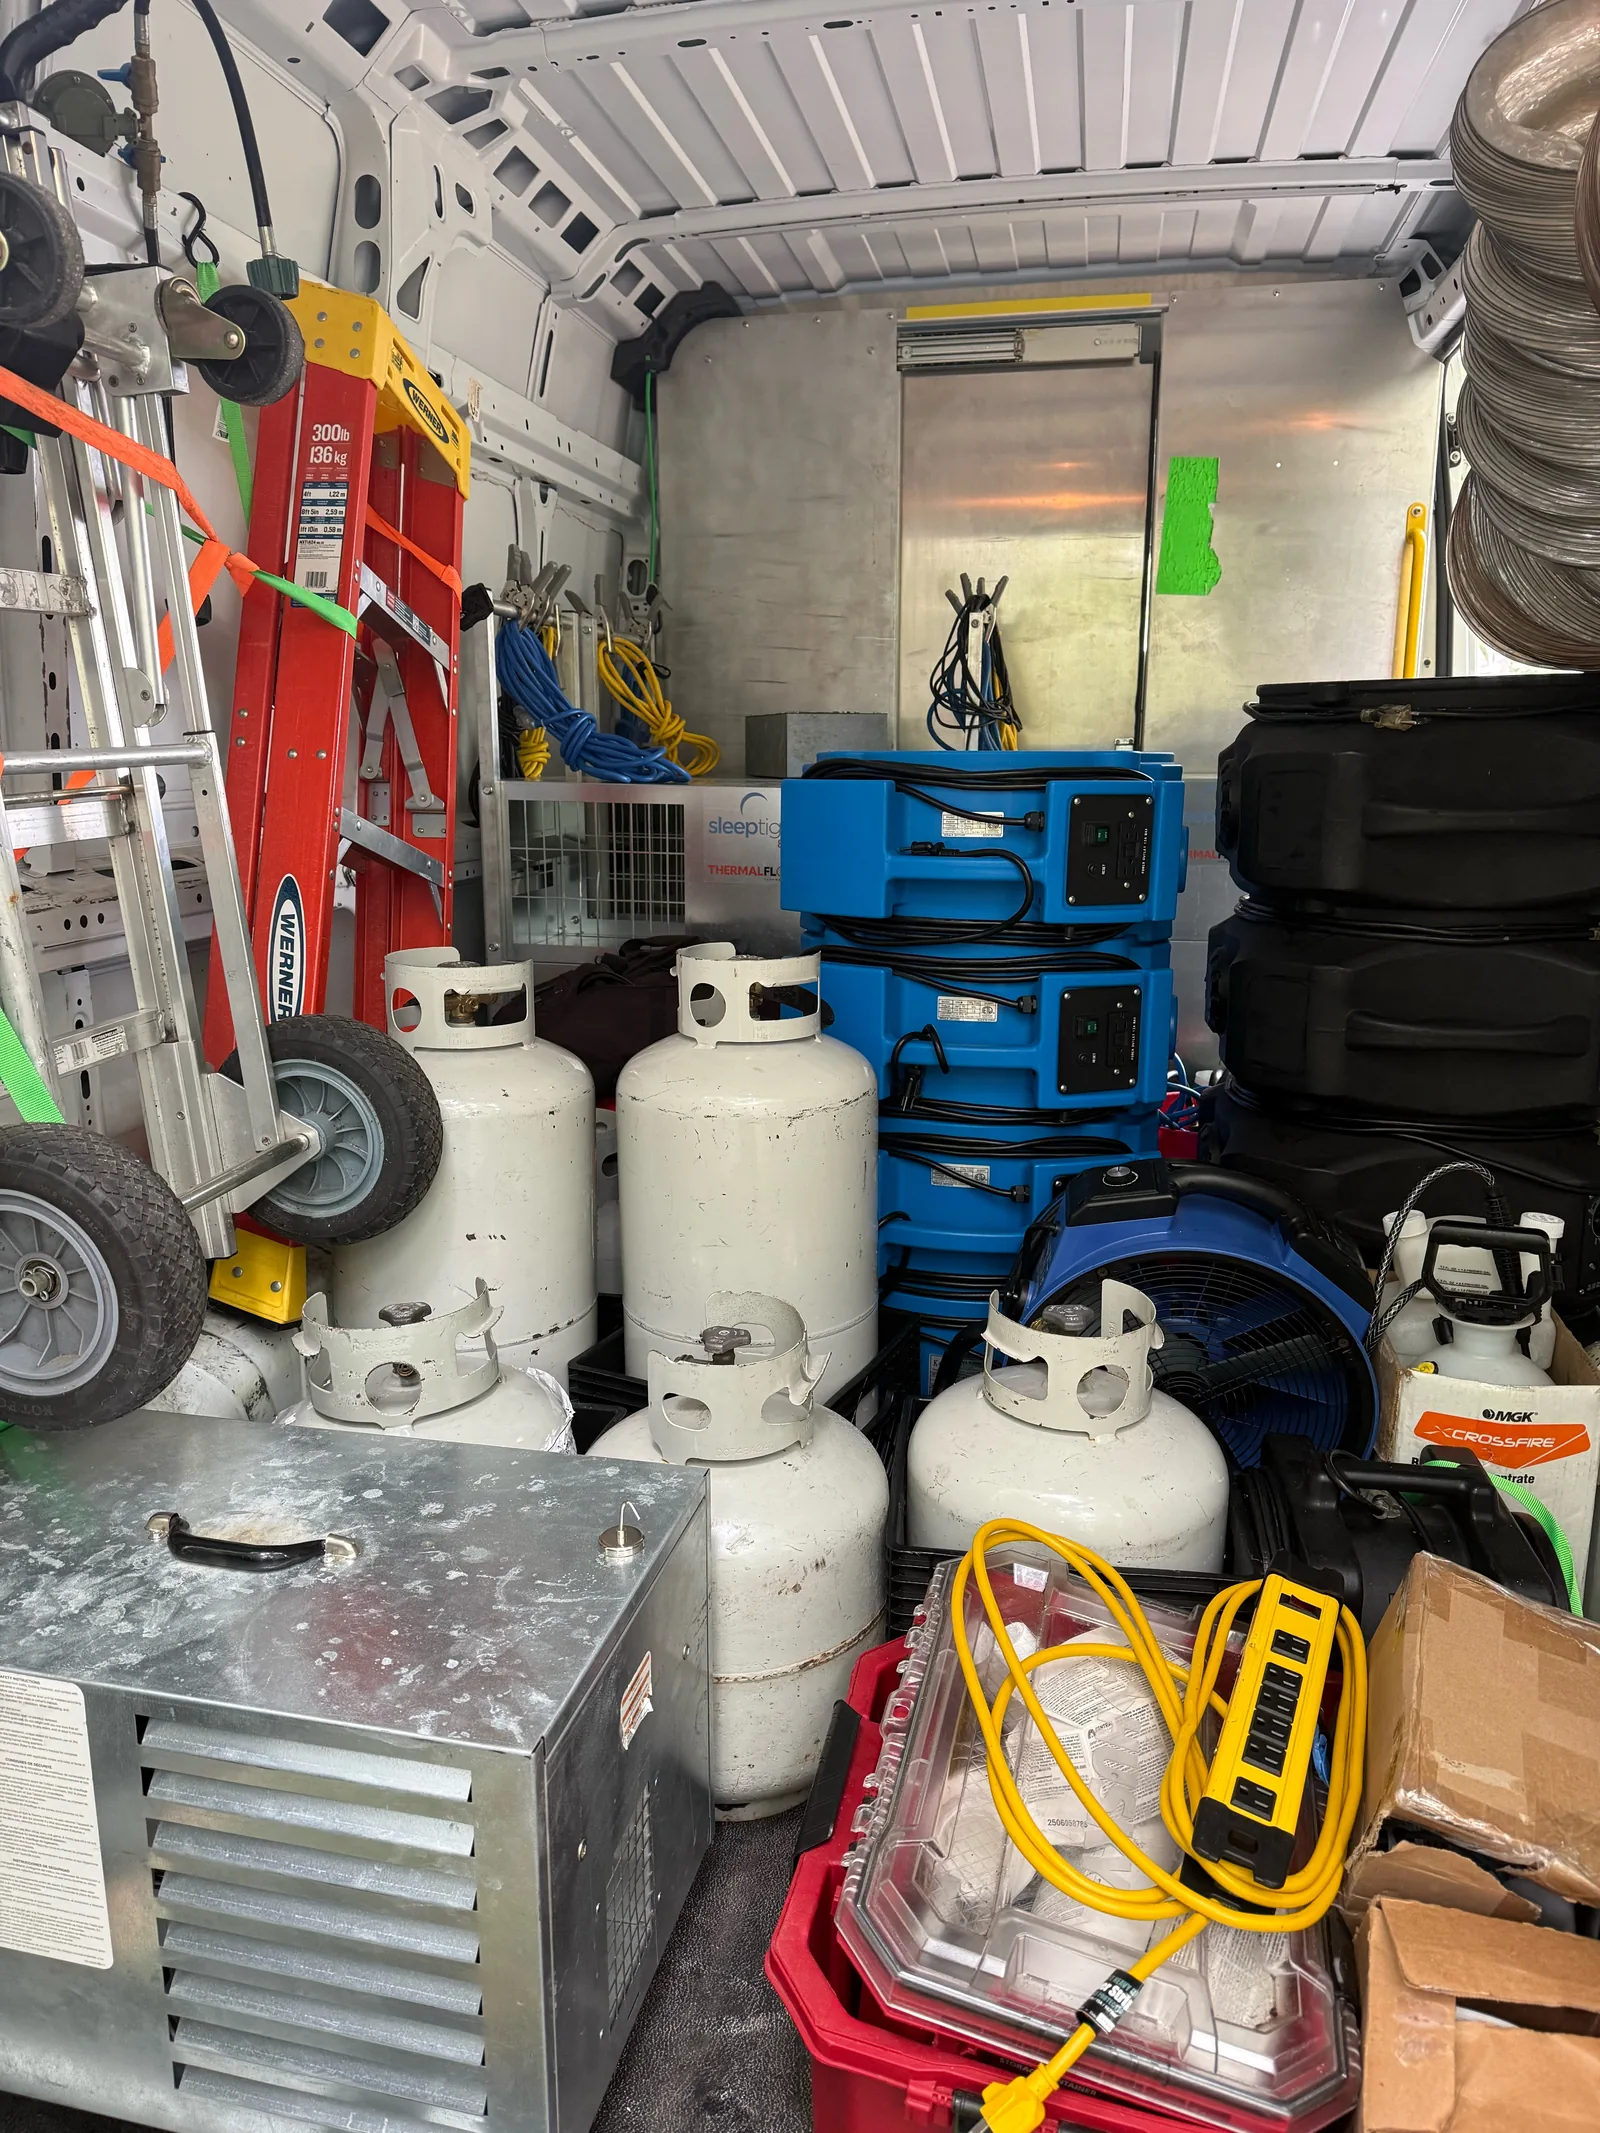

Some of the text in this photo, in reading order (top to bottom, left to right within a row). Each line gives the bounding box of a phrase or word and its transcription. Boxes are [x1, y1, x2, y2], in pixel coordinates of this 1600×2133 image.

[412, 389, 442, 433] WERNER
[312, 424, 350, 441] 300lb
[310, 445, 348, 466] 136 kg
[708, 816, 781, 839] sleeptig
[708, 864, 781, 877] THERMALFL
[278, 913, 295, 1021] WERNER
[1495, 1410, 1533, 1422] MGK
[1497, 1473, 1535, 1484] ntrate
[1000, 2056, 1097, 2096] STORAG NTAINER
